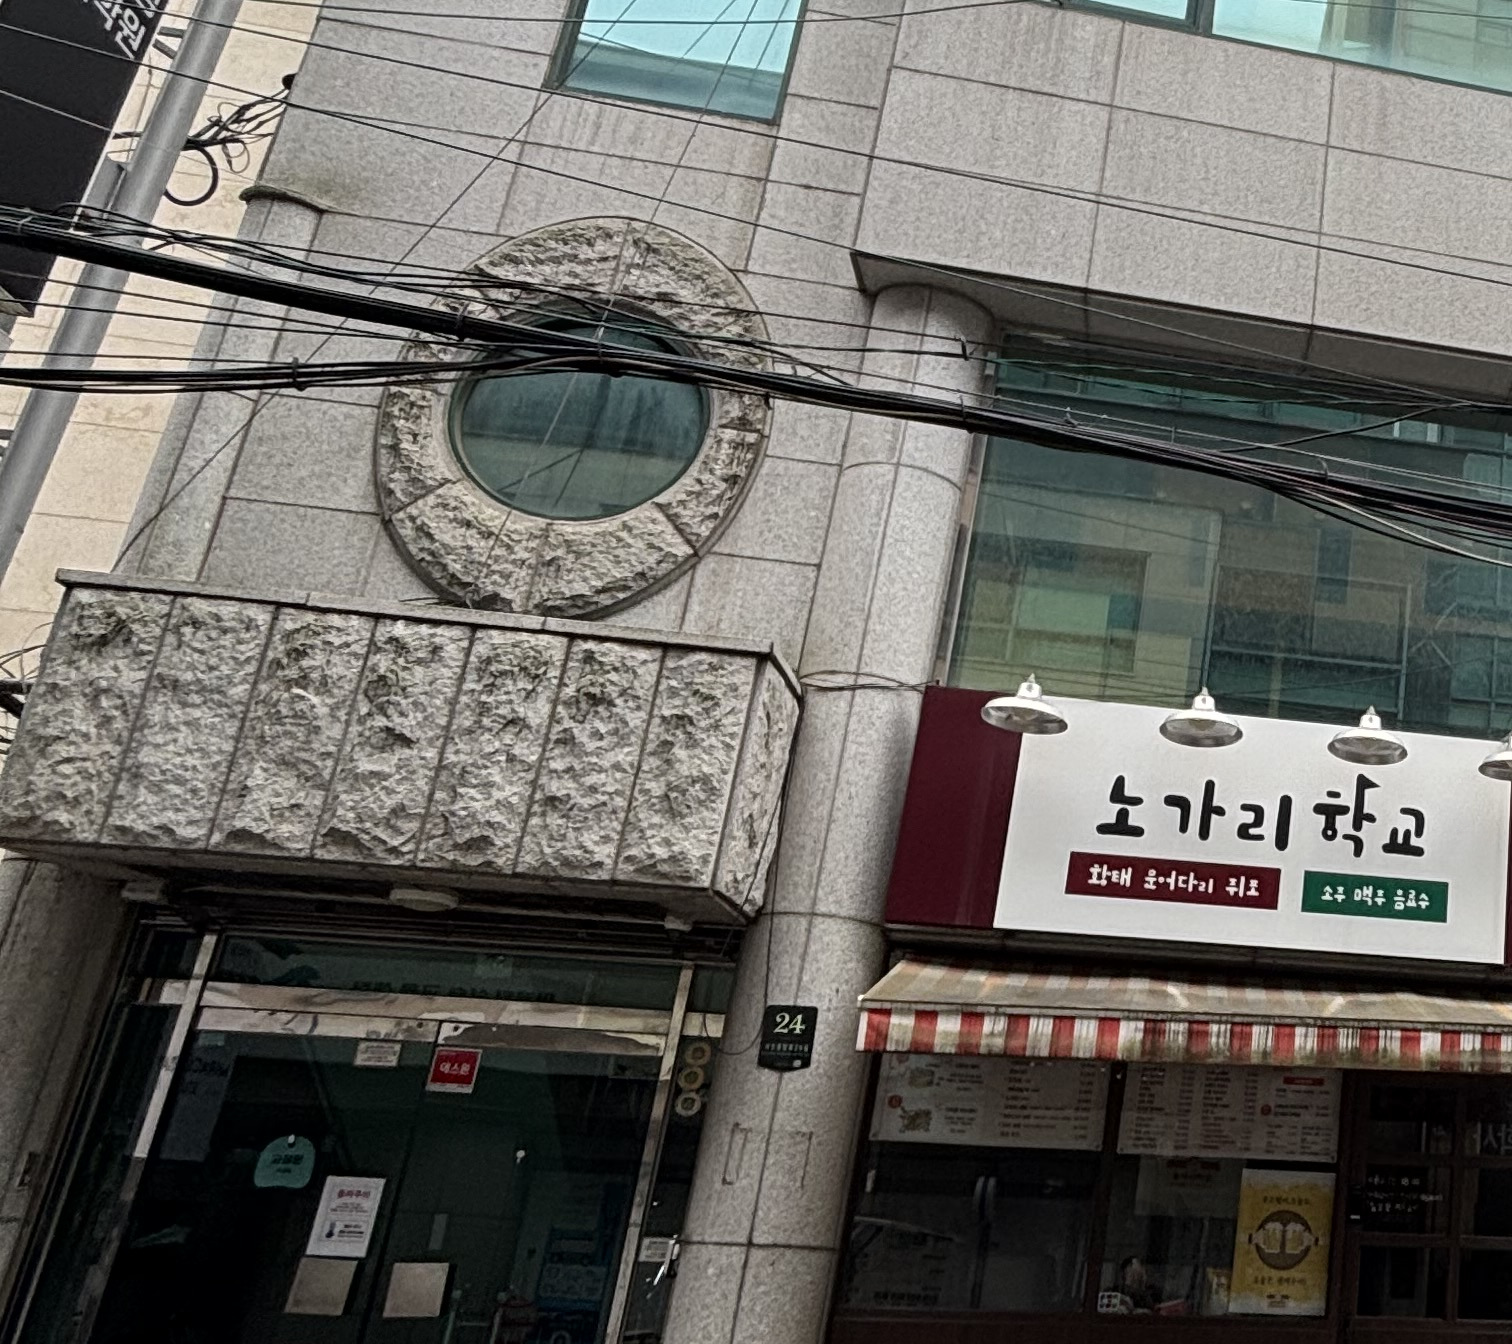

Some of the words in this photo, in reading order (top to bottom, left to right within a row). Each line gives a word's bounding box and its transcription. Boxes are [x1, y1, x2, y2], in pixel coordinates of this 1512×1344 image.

[1096, 774, 1426, 858] 노가리학교
[1088, 864, 1132, 887] 황태
[1144, 868, 1214, 894] 문어다리
[1226, 876, 1260, 897] 쥐포
[1321, 885, 1346, 902] 소주
[1354, 885, 1386, 906] 맥주
[1394, 889, 1430, 910] 음료수
[773, 1012, 806, 1034] 24
[440, 1061, 470, 1075] 에스원
